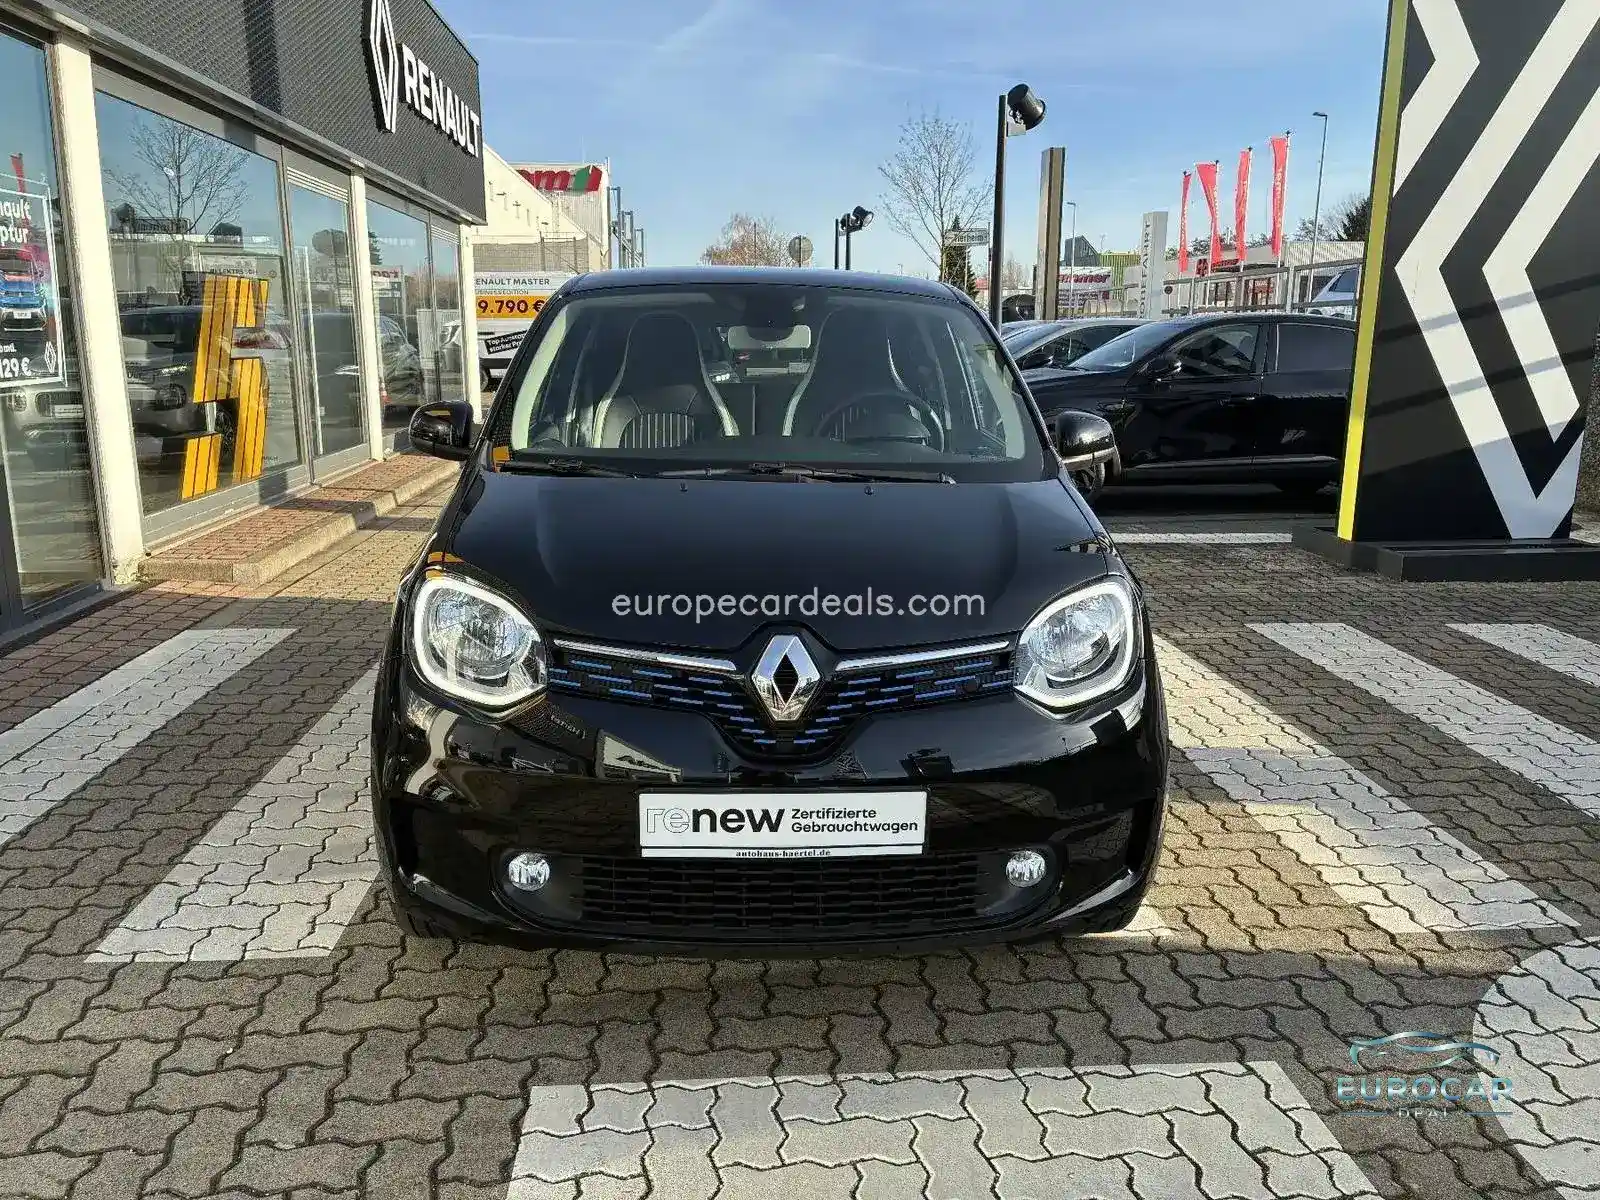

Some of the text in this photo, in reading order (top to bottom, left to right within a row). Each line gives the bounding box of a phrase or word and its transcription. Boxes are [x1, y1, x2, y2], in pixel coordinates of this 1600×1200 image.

[402, 43, 479, 157] RENAULT
[478, 299, 529, 313] 9.790
[646, 807, 877, 834] renew Zertifizierte
[791, 821, 919, 835] Gebrauchtwagen
[735, 849, 832, 858] autohaus-haertel.de
